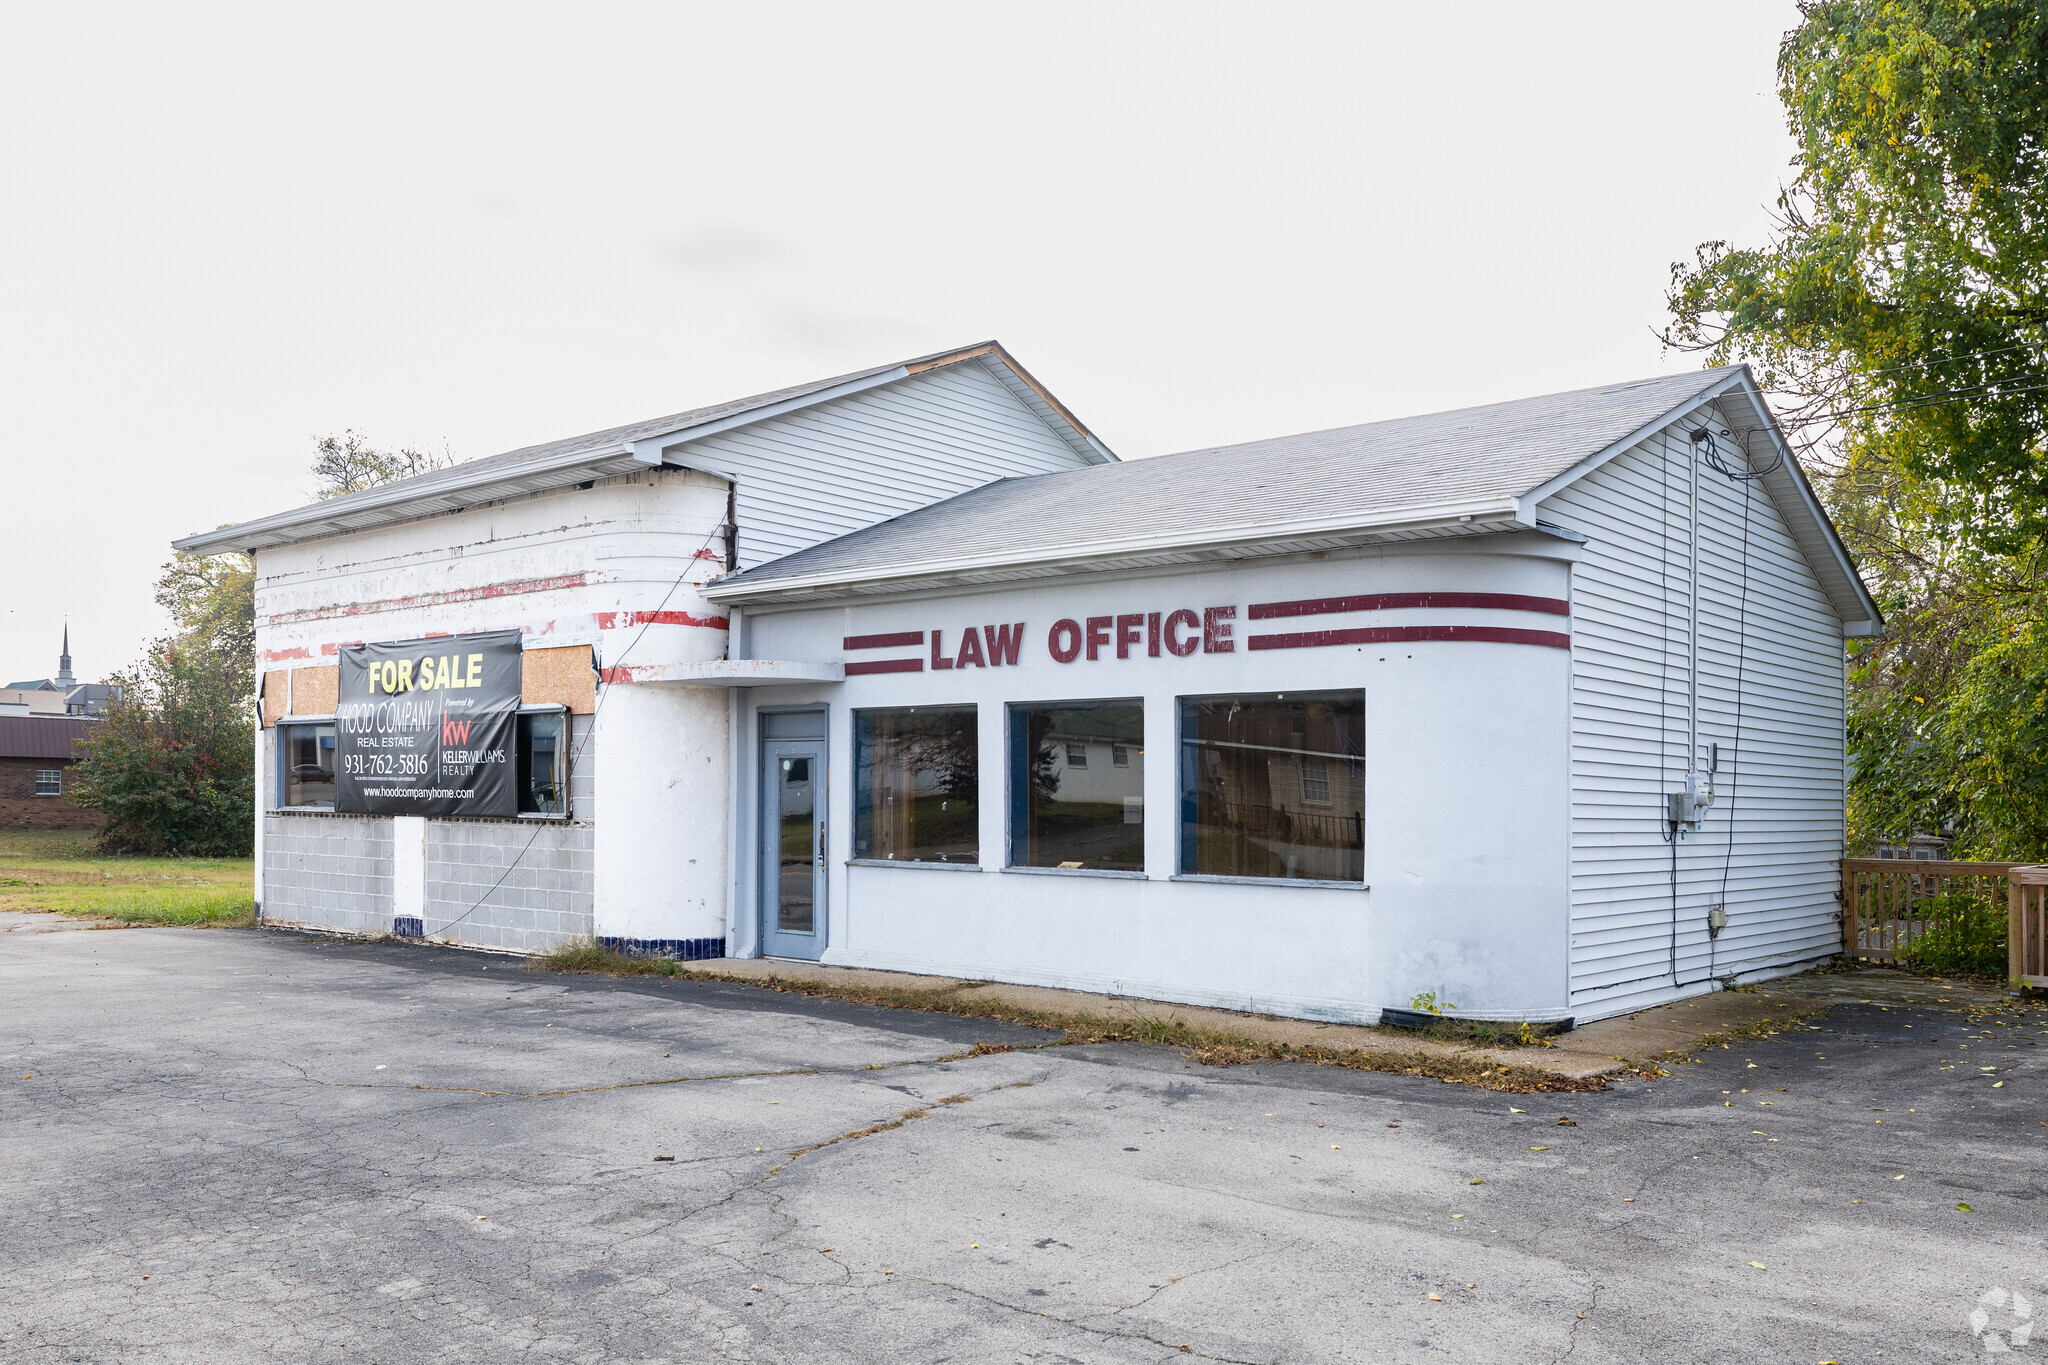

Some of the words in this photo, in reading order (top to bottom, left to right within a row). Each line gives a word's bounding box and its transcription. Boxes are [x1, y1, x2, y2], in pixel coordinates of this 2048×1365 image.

[931, 622, 1025, 670] LAW
[1048, 605, 1237, 664] OFFICE
[369, 659, 413, 694] FOR
[419, 653, 483, 690] SALE
[445, 699, 467, 707] Powered
[467, 698, 475, 708] by
[341, 702, 375, 734] HOOD
[376, 700, 435, 734] COMPANY
[357, 737, 380, 748] REAL
[381, 736, 414, 748] ESTATE
[344, 753, 428, 775] 931-762-5816
[442, 765, 475, 776] REALTY
[363, 785, 475, 801] www.hoodcompanyhome.com
